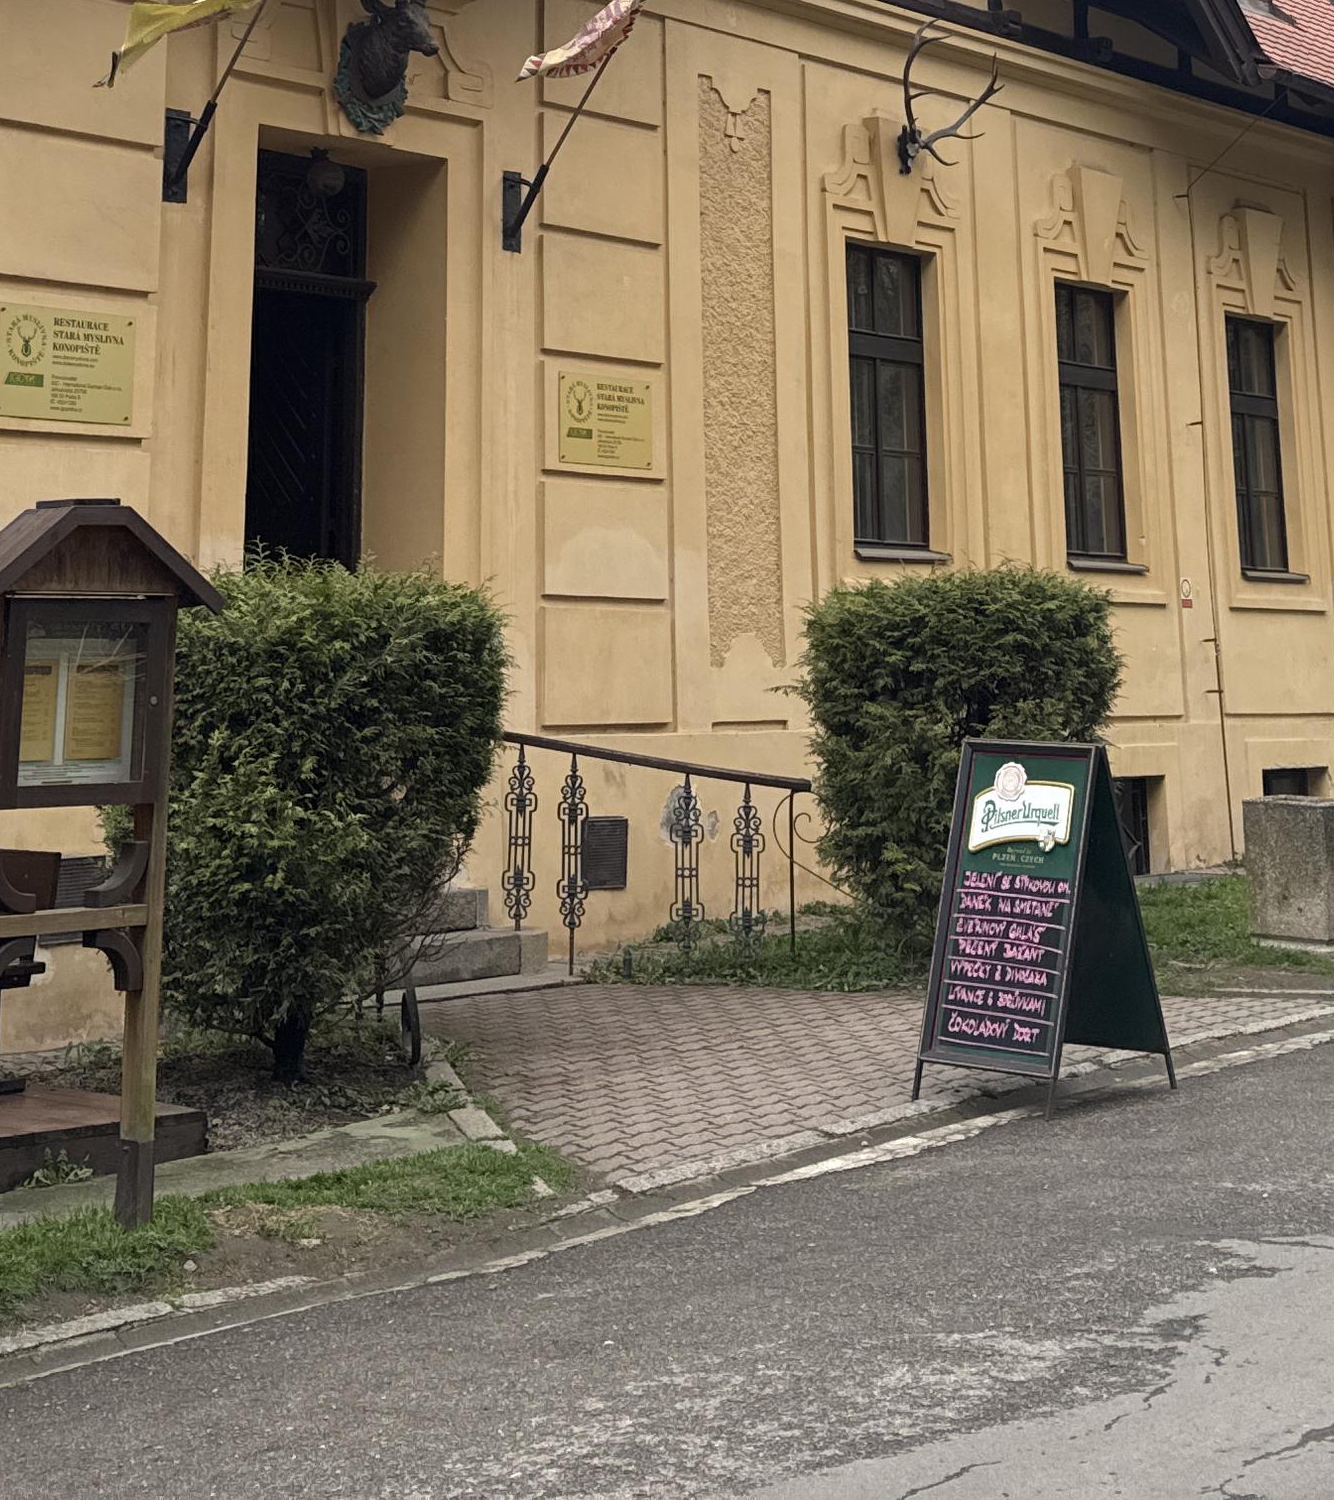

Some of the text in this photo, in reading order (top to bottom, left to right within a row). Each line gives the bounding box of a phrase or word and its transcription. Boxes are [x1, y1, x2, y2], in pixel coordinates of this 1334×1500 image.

[53, 317, 109, 331] RESTAURACE
[53, 329, 124, 346] STARÁ MYSLIVNA
[52, 342, 101, 356] KONOPIŠTĚ
[981, 799, 1060, 833] Pilsner Urquell
[1020, 855, 1044, 864] CZECH
[997, 897, 1011, 913] NA
[948, 1010, 1040, 1043] ČOKOLÁDOVÝ DORT
